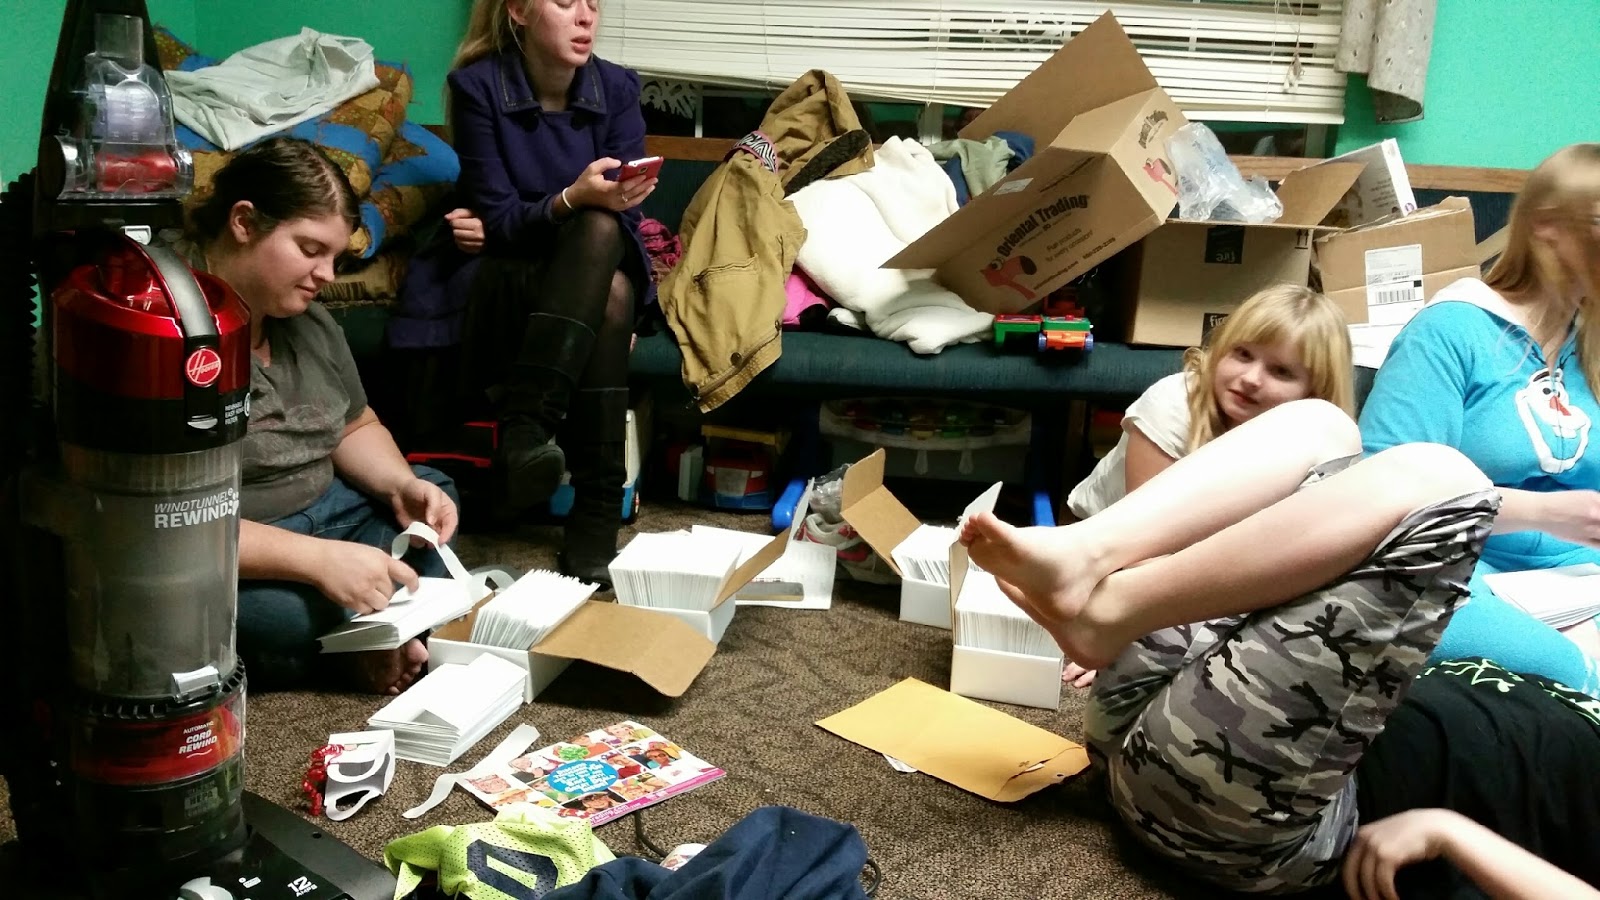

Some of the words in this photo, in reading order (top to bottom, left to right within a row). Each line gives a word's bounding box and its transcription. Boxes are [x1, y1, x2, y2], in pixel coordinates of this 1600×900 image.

[997, 214, 1039, 258] Oriental
[1035, 194, 1089, 222] Trading
[154, 491, 229, 513] WINDTUNNEL
[154, 501, 229, 529] REWIND
[178, 735, 218, 754] REWIND
[186, 729, 212, 744] CORD
[287, 876, 312, 893] 12
[296, 884, 318, 898] AMPS
